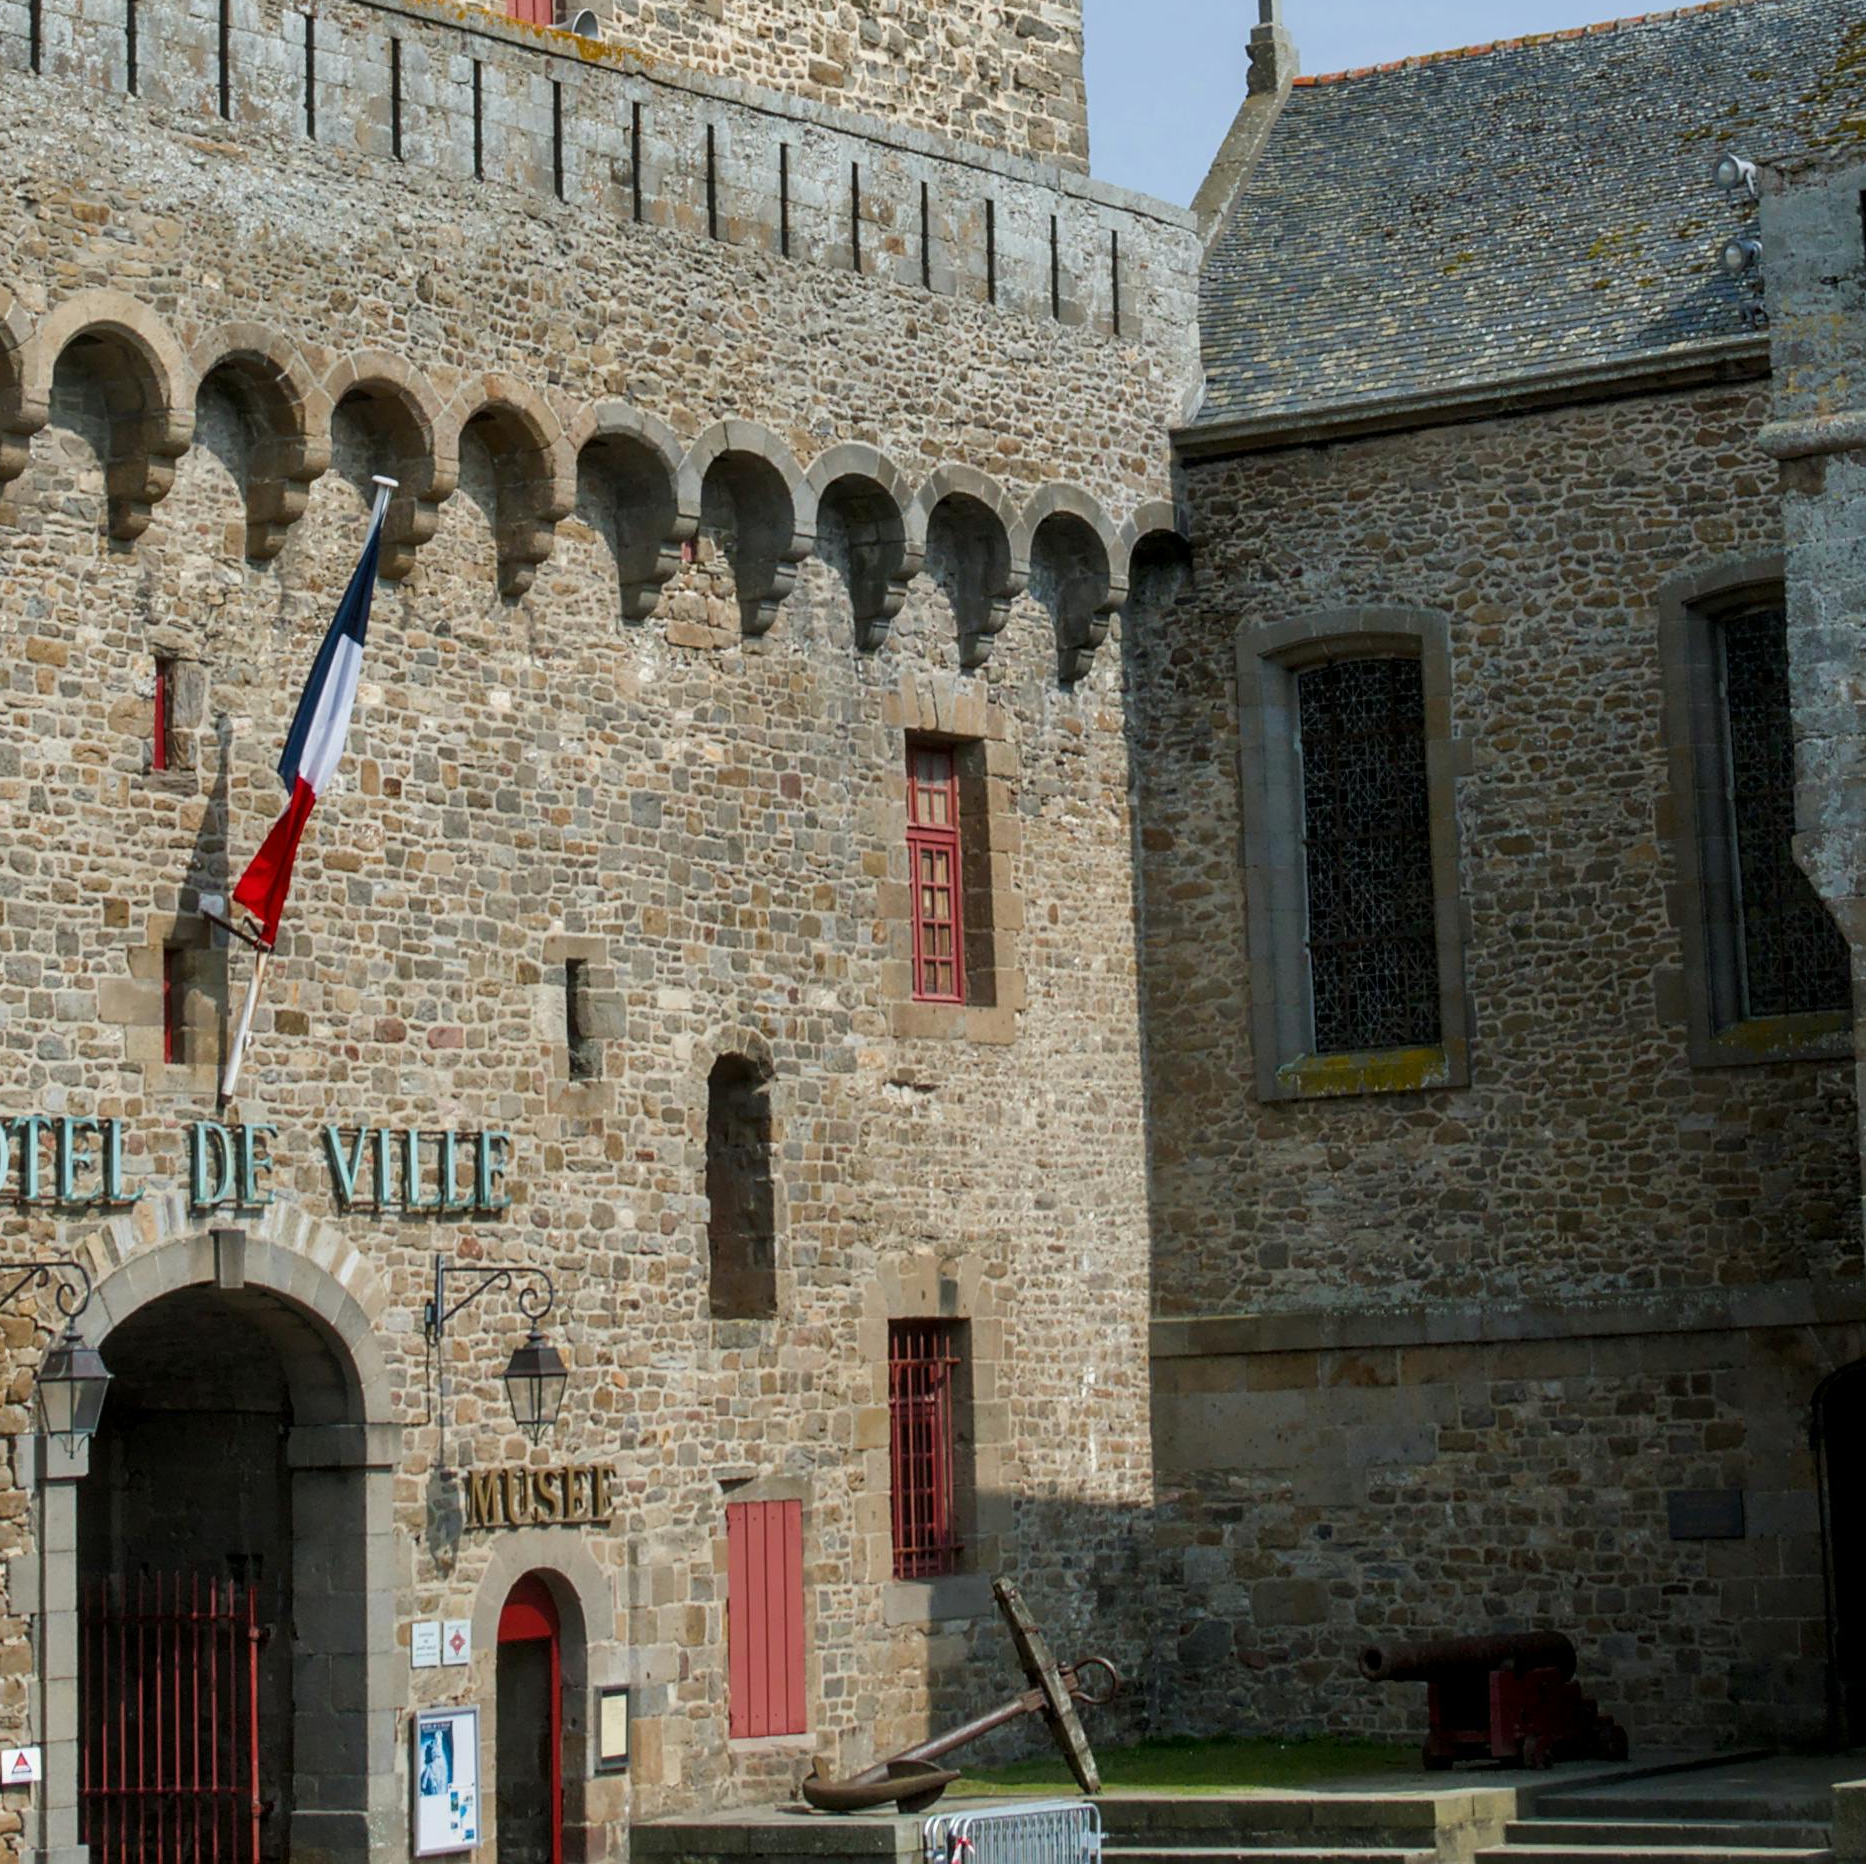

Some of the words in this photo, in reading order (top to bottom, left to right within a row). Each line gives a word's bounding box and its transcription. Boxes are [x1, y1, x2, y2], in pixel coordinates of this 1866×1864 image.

[192, 1121, 278, 1205] DE
[324, 1124, 512, 1209] VILLE
[466, 1463, 617, 1528] MUSEE
